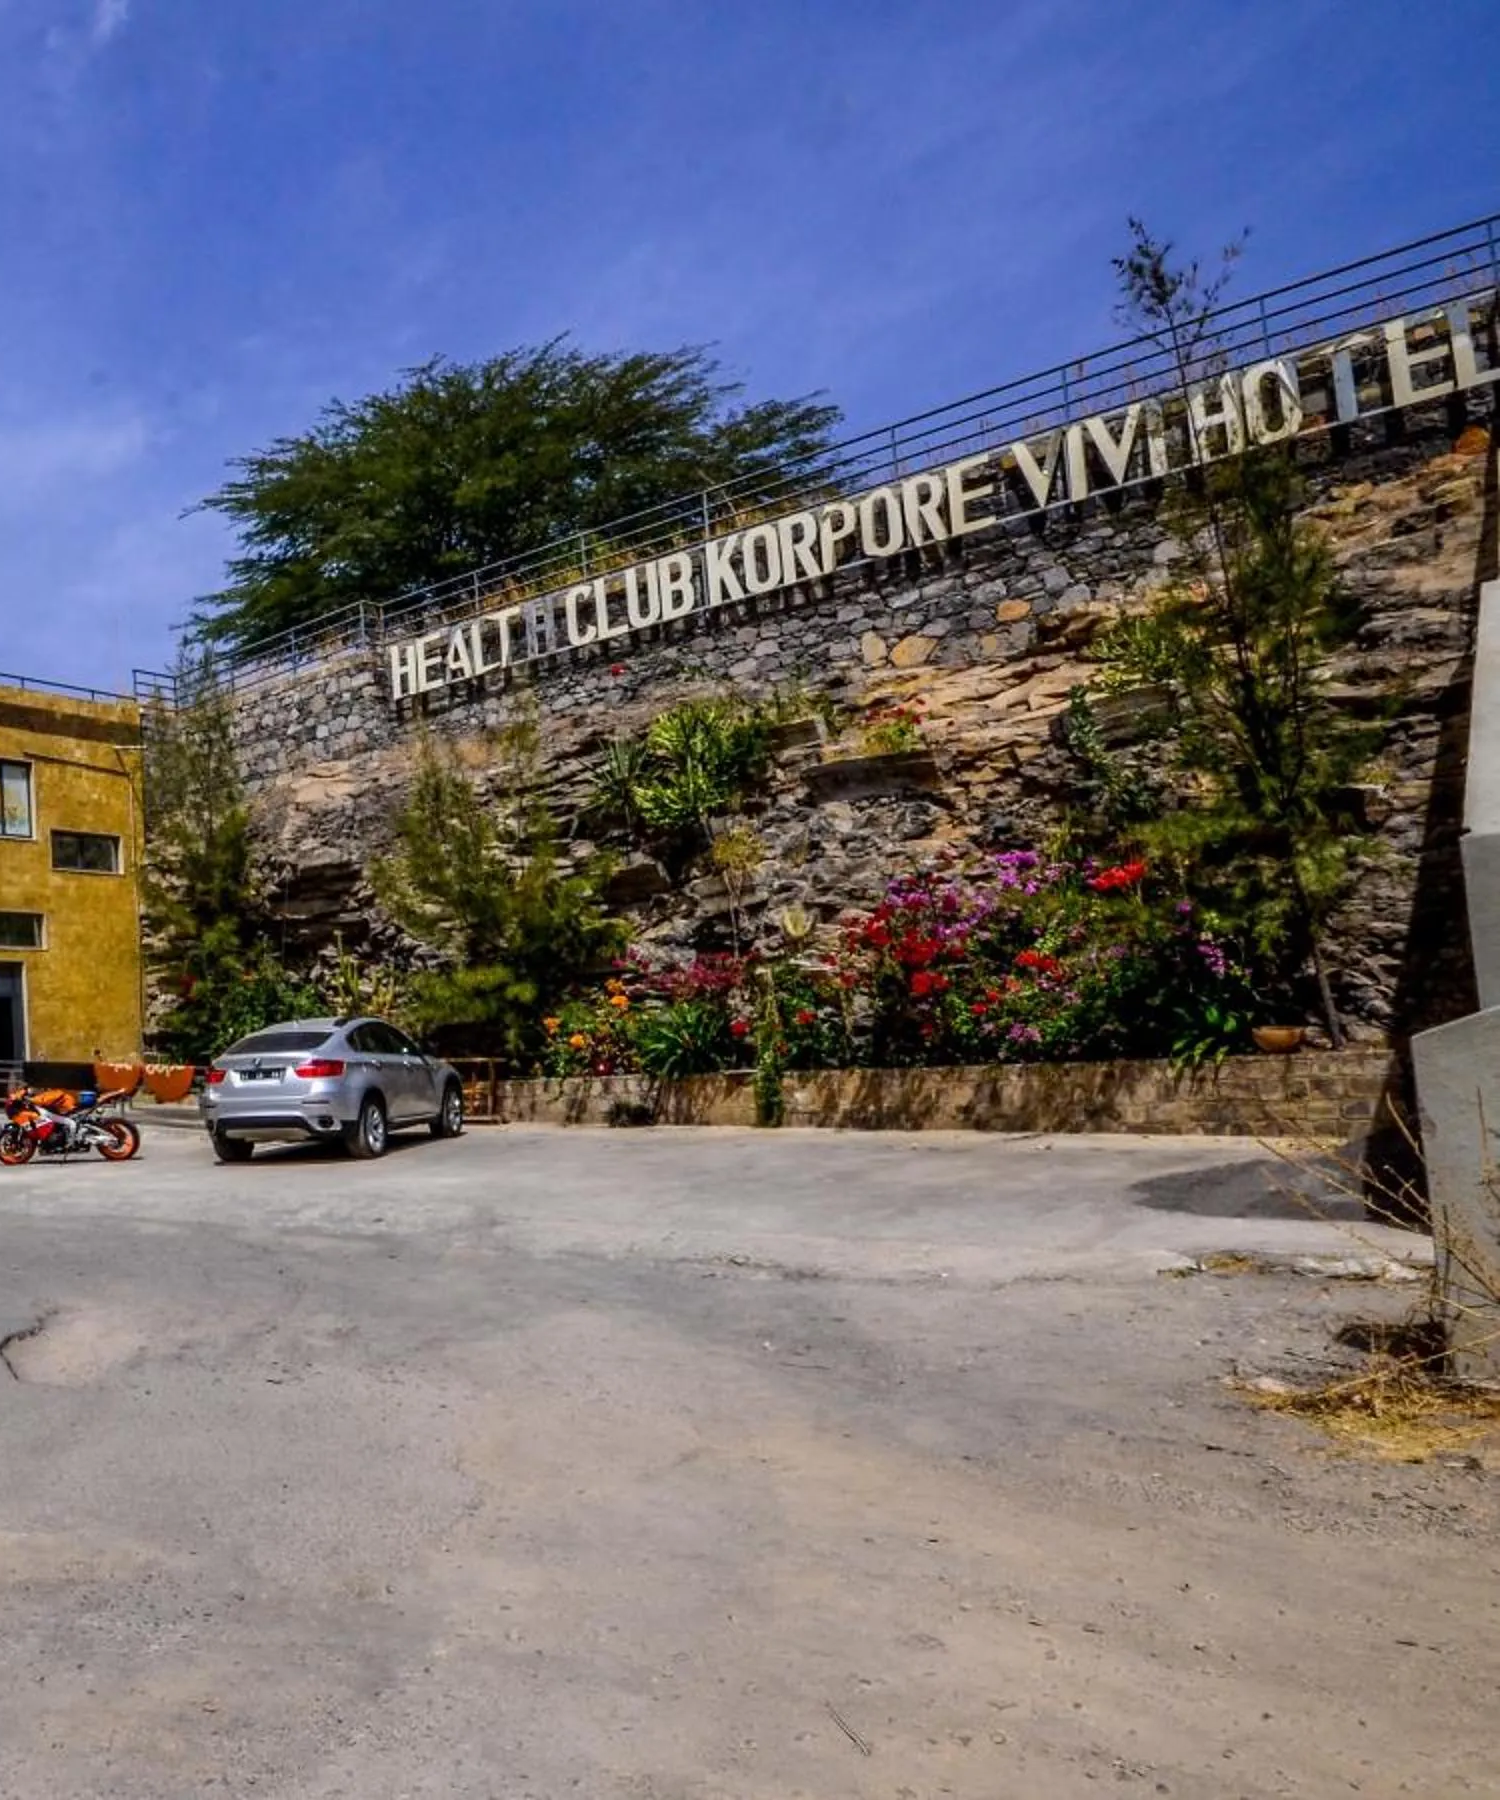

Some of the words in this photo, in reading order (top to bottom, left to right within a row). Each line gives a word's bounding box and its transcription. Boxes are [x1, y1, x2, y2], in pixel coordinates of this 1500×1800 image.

[390, 598, 557, 699] HEALTH
[566, 552, 695, 646] CLUB
[705, 457, 996, 606] KORPORE
[1013, 397, 1166, 508] VIVI
[1186, 298, 1500, 462] HOTEL
